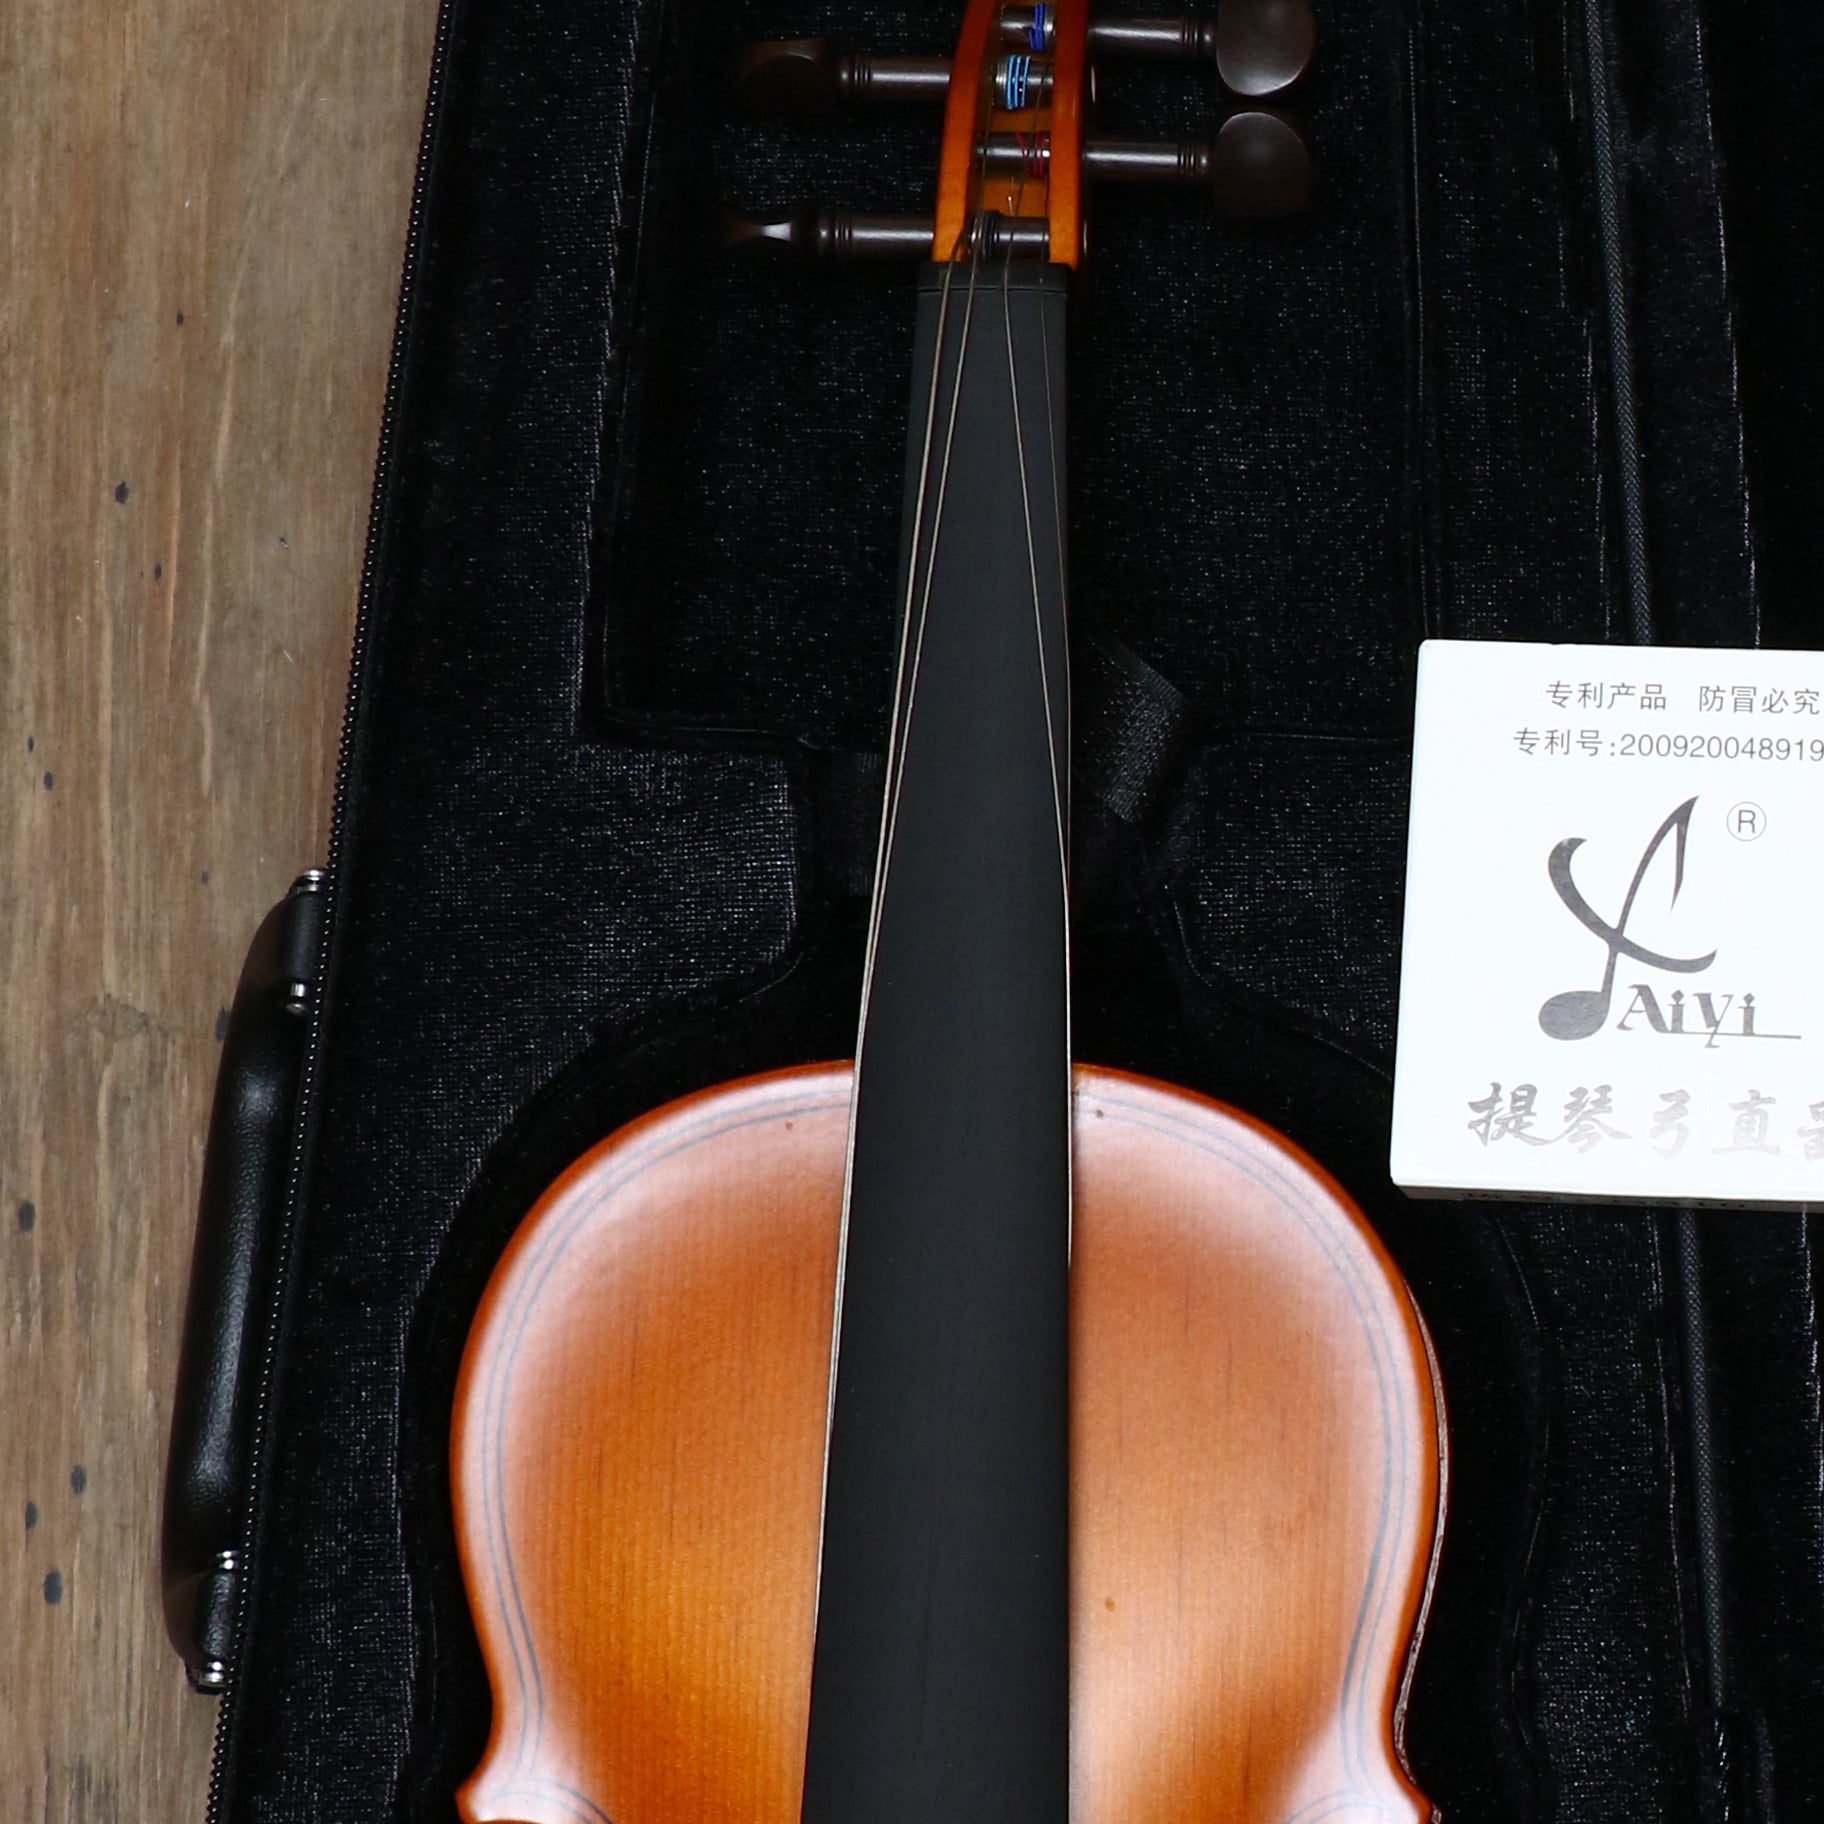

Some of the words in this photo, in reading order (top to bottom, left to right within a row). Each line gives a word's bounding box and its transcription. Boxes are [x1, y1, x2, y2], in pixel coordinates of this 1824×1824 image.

[1545, 680, 1668, 711] 专利产品
[1698, 684, 1821, 716] 防冒必究
